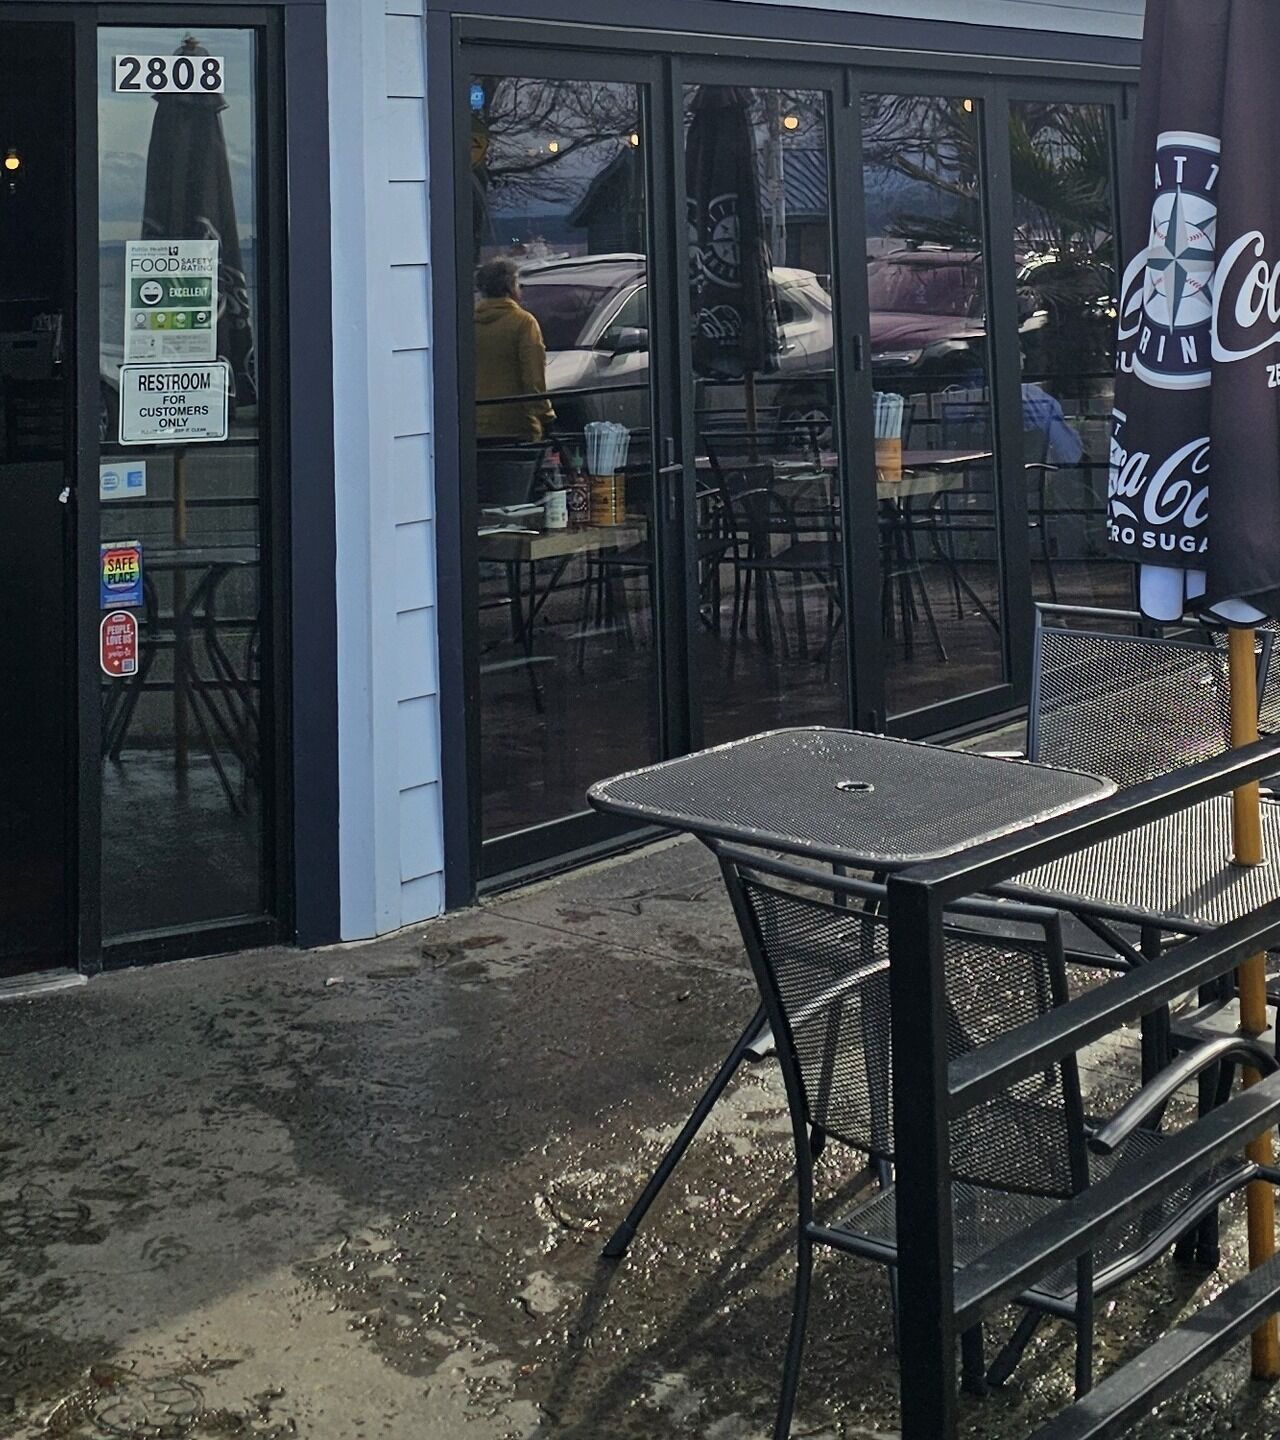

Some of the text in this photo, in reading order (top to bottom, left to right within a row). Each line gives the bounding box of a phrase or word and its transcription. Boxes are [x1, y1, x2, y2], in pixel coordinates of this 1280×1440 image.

[119, 57, 222, 91] 2808
[130, 258, 180, 272] FOOD
[181, 257, 213, 265] SAFETY
[169, 286, 208, 298] EXCELLENT
[138, 373, 211, 392] RESTROOM
[162, 395, 186, 405] FOR
[139, 405, 209, 418] CUSTOMERS
[158, 418, 189, 428] ONLY
[108, 557, 135, 572] SAFE
[107, 571, 135, 585] PLACE
[107, 623, 132, 635] PEOPLE
[106, 633, 132, 646] LOVE US
